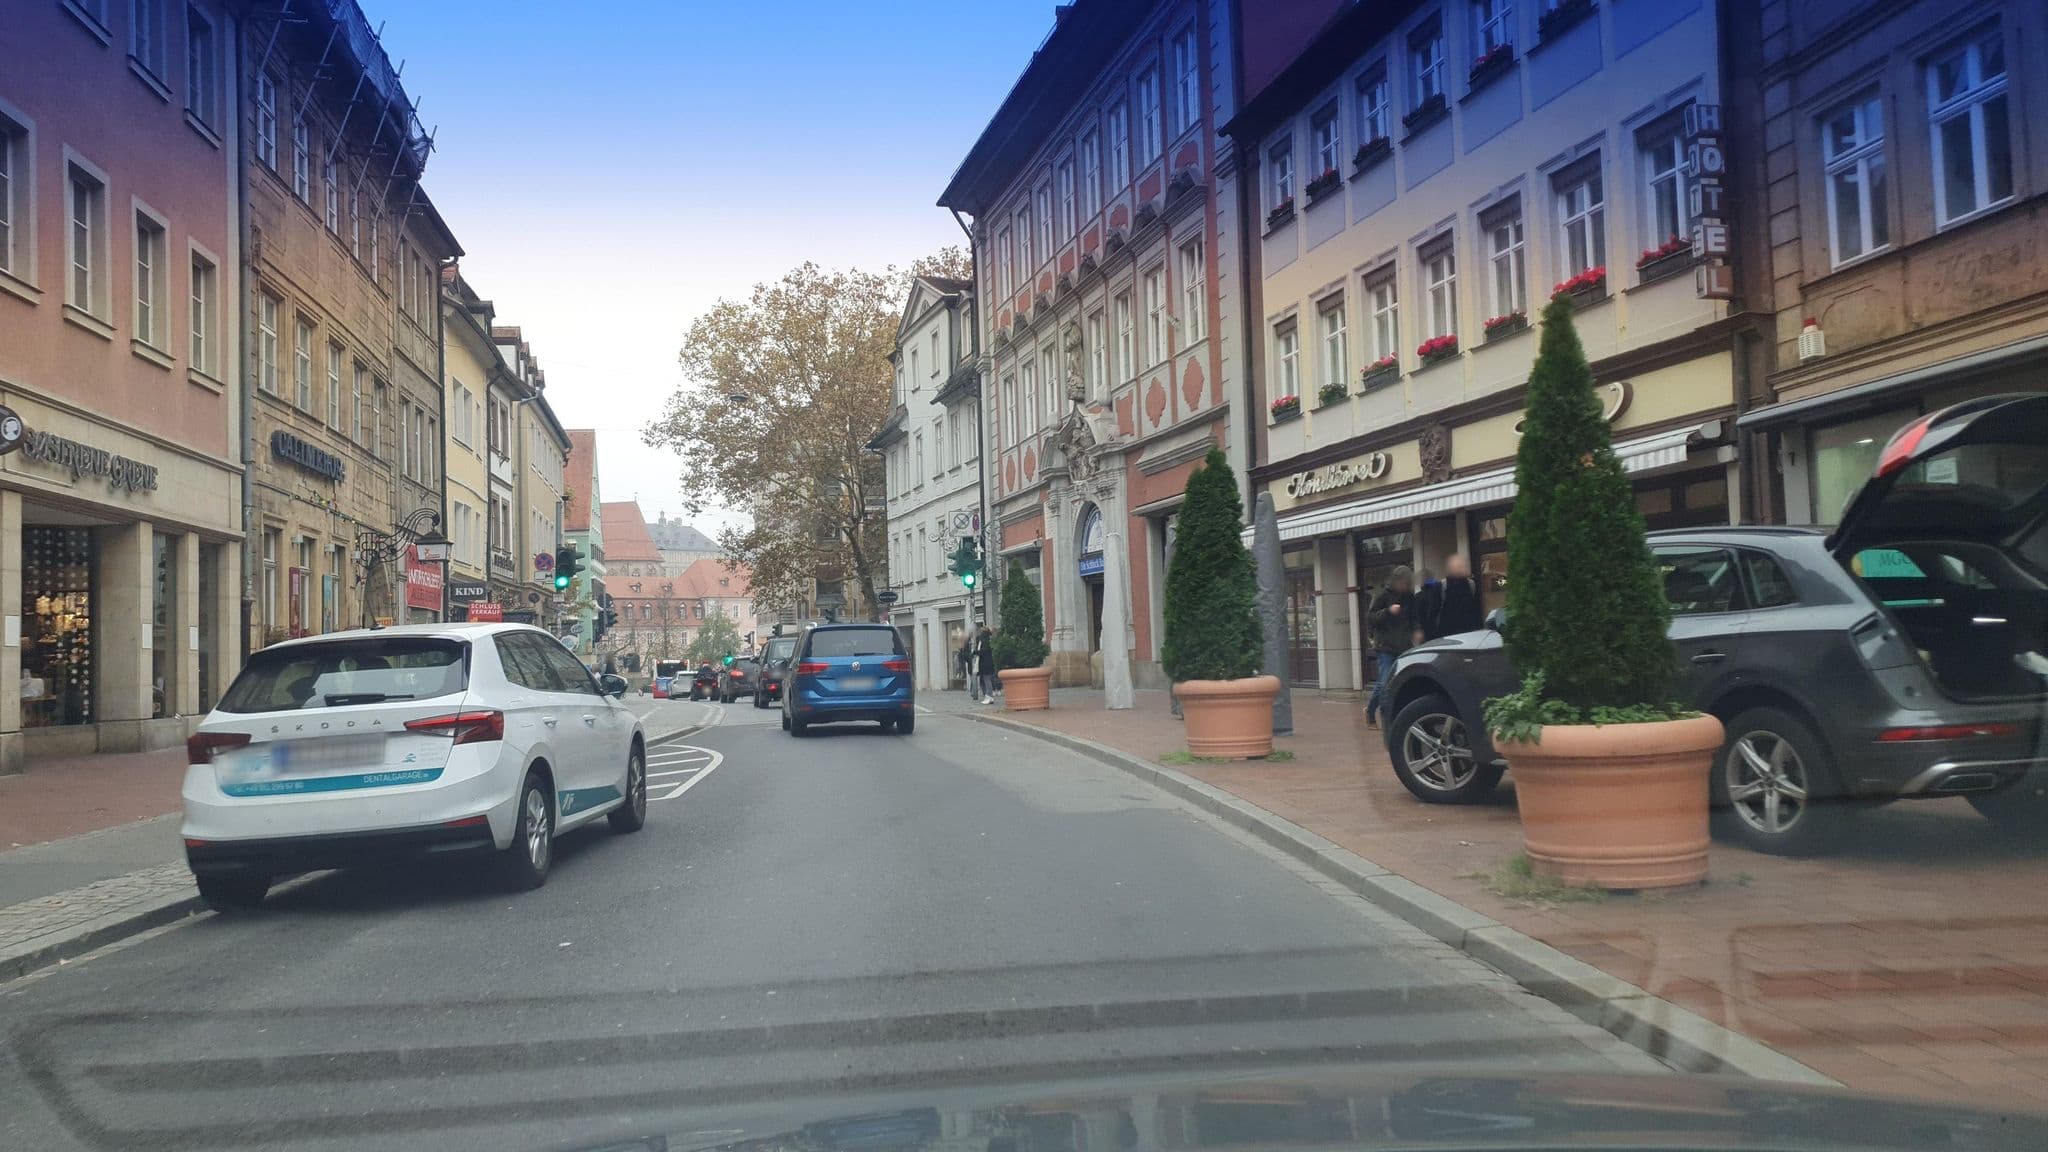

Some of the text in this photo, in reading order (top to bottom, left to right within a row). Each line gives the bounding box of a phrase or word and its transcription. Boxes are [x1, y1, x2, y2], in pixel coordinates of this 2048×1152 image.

[1701, 105, 1729, 293] HOTEL
[1287, 452, 1386, 499] Konditorei
[455, 587, 484, 596] KIND
